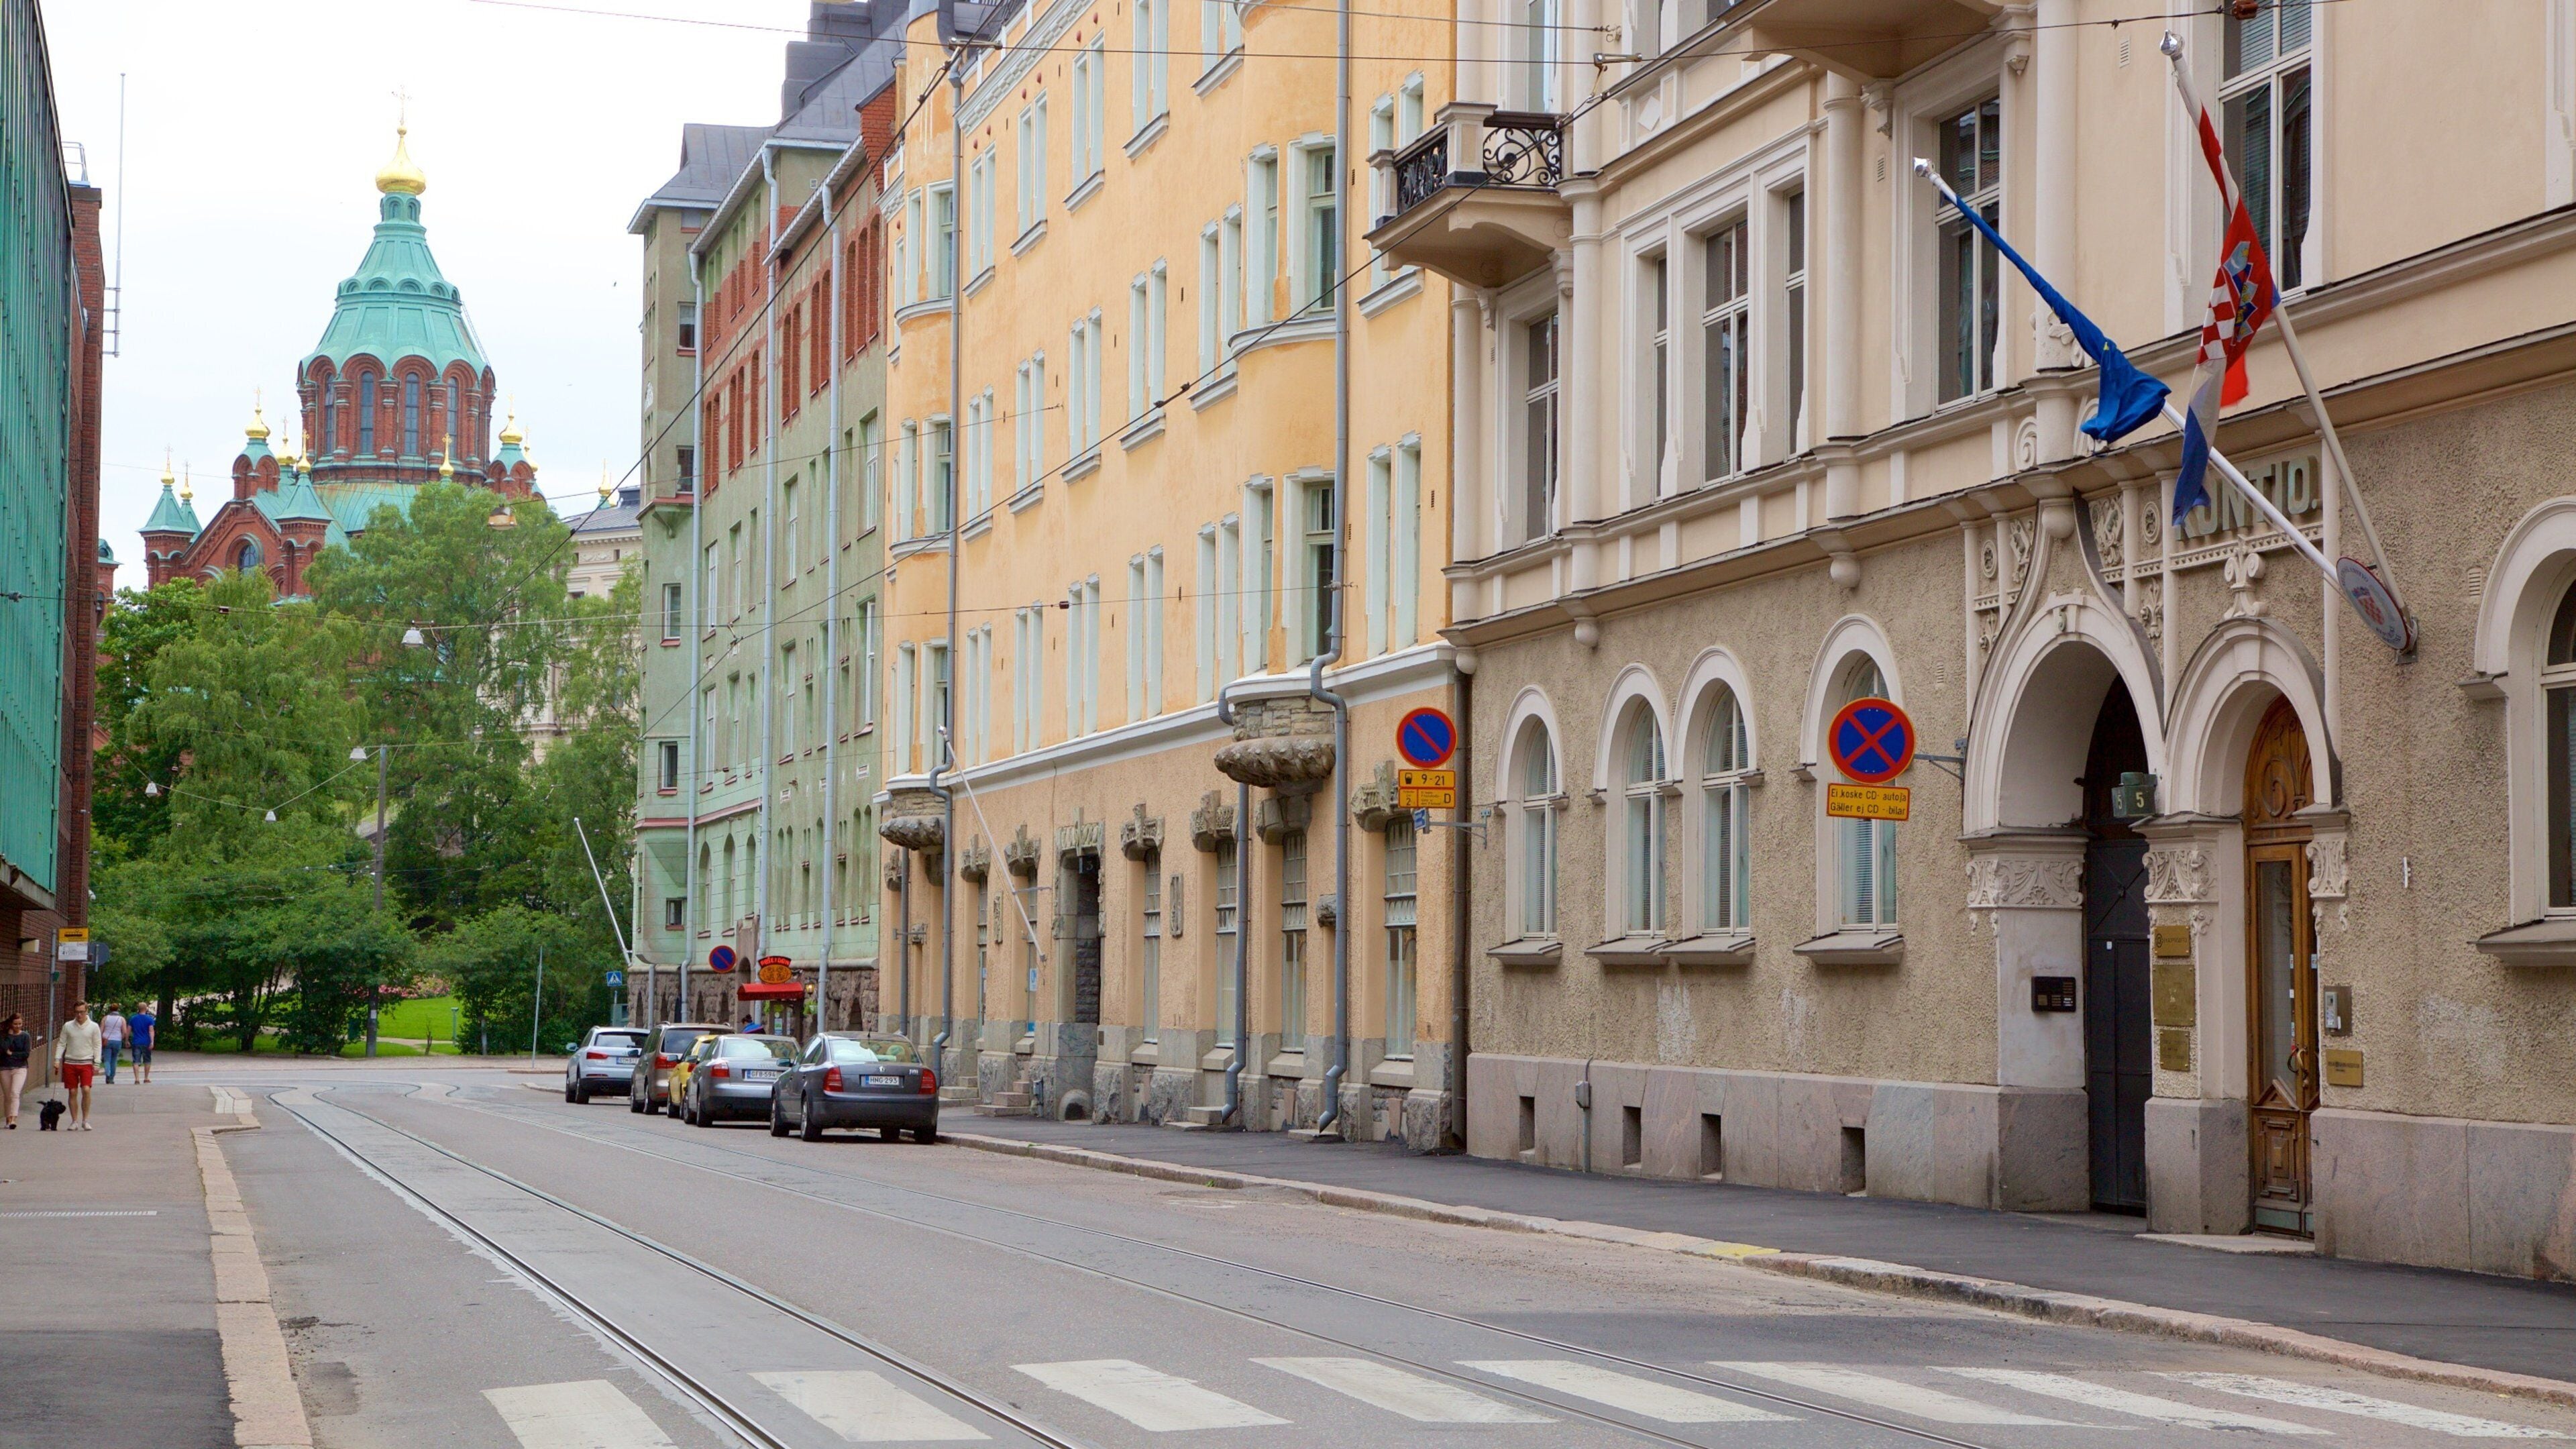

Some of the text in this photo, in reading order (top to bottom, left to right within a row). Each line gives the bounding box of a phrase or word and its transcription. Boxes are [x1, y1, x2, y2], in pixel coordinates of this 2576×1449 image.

[2174, 456, 2317, 541] ONTIO.
[1406, 797, 1411, 806] 2
[1444, 793, 1452, 804] D
[1831, 788, 1838, 798] Ei
[1840, 789, 1863, 799] koske
[1882, 793, 1907, 802] autoja
[2136, 792, 2145, 808] 5
[1830, 802, 1853, 812] Gäller
[1856, 805, 1864, 814] ej
[1888, 806, 1906, 815] bilar
[2117, 795, 2123, 810] 5
[869, 1075, 898, 1084] HNG-293
